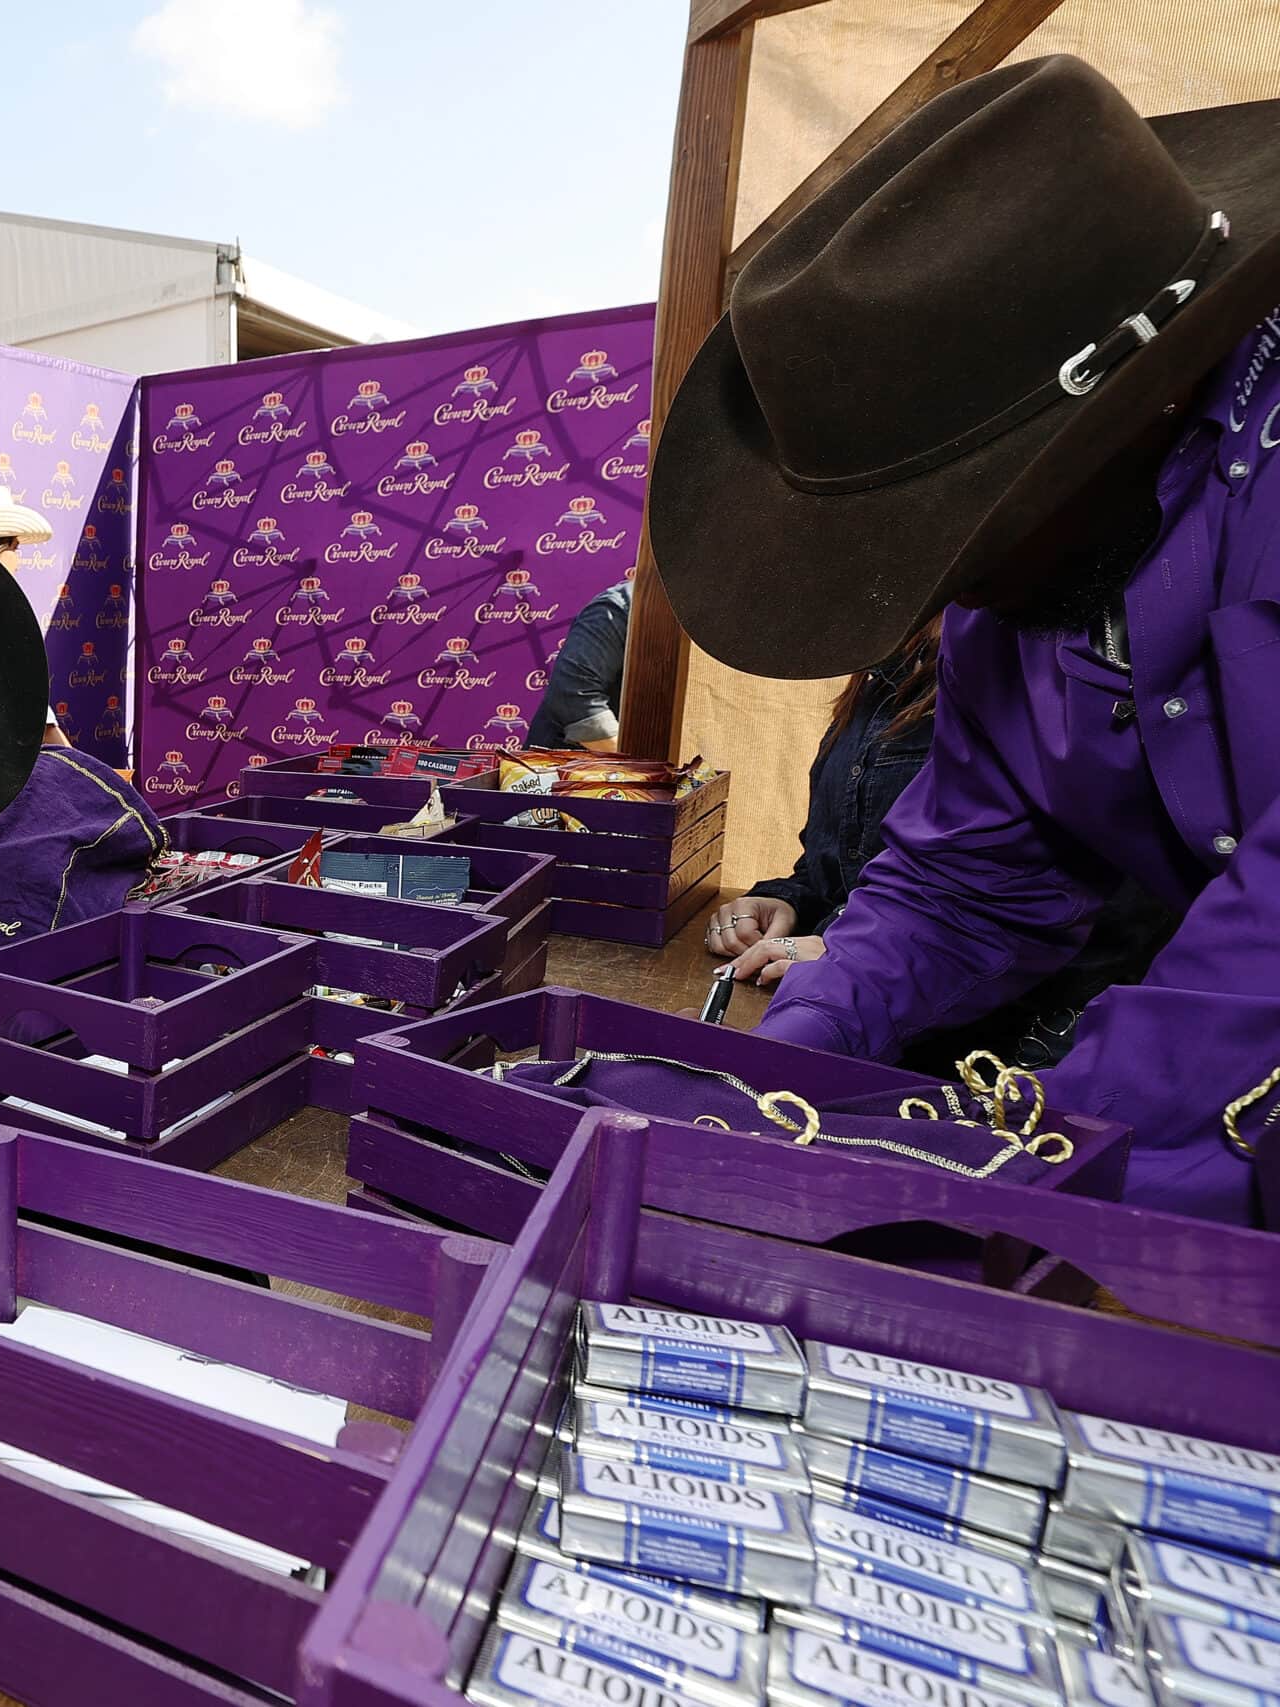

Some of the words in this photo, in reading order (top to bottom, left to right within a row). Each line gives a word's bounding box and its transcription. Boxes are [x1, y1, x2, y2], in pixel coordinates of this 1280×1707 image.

[547, 390, 587, 413] Crown
[578, 384, 639, 410] Royal
[434, 404, 470, 425] Crown
[462, 398, 516, 423] Royal
[239, 426, 270, 445] Crown
[263, 422, 306, 443] Royal
[331, 415, 365, 436] Crown
[357, 411, 406, 433] Royal
[153, 435, 183, 454] Crown
[175, 432, 215, 452] Royal
[484, 467, 520, 488] Crown
[513, 463, 569, 486] Royal
[601, 457, 645, 480] Crown
[281, 484, 312, 503] Crown
[306, 481, 351, 502] Royal
[378, 476, 413, 496] Crown
[404, 472, 455, 494] Royal
[193, 491, 224, 510] Crown
[216, 489, 256, 508] Royal
[325, 543, 360, 563] Crown
[352, 542, 398, 562] Royal
[425, 538, 460, 559] Crown
[452, 537, 506, 558] Royal
[536, 532, 576, 555] Crown
[566, 531, 626, 553] Royal
[149, 554, 179, 571] Crown
[172, 551, 211, 570] Royal
[233, 548, 263, 567] Crown
[256, 546, 300, 567] Royal
[189, 609, 218, 627] Crown
[211, 607, 252, 626] Royal
[276, 607, 307, 626] Crown
[300, 607, 345, 626] Royal
[371, 605, 404, 625] Crown
[397, 604, 447, 625] Royal
[475, 603, 513, 623] Crown
[505, 602, 559, 624] Royal
[148, 666, 176, 684] Crown
[169, 666, 208, 684] Royal
[230, 666, 260, 684] Crown
[253, 666, 296, 686] Royal
[320, 667, 351, 686] Crown
[345, 666, 391, 687] Royal
[418, 669, 452, 689] Crown
[446, 669, 496, 690] Royal
[526, 670, 550, 691] Cro
[186, 723, 215, 740] Crown
[208, 723, 248, 742] Royal
[272, 726, 302, 744] Crown
[296, 726, 339, 746] Royal
[364, 730, 398, 744] Crown
[391, 731, 439, 747] Royal
[428, 761, 456, 772] CALORIES
[146, 777, 173, 793] Crown
[166, 777, 205, 795] Royal
[511, 775, 541, 792] Baked
[612, 1307, 760, 1339] ALTOIDS
[840, 1351, 1015, 1401] ALTOIDS
[609, 1407, 768, 1449] ALTOIDS
[1099, 1423, 1280, 1472] ALTOID
[596, 1464, 767, 1511] ALTOIDS
[826, 1521, 1014, 1595] ALTOIDS
[543, 1572, 725, 1650] ALTOIDS
[518, 1647, 686, 1707] ALTOID
[809, 1643, 998, 1707] ALTOID
